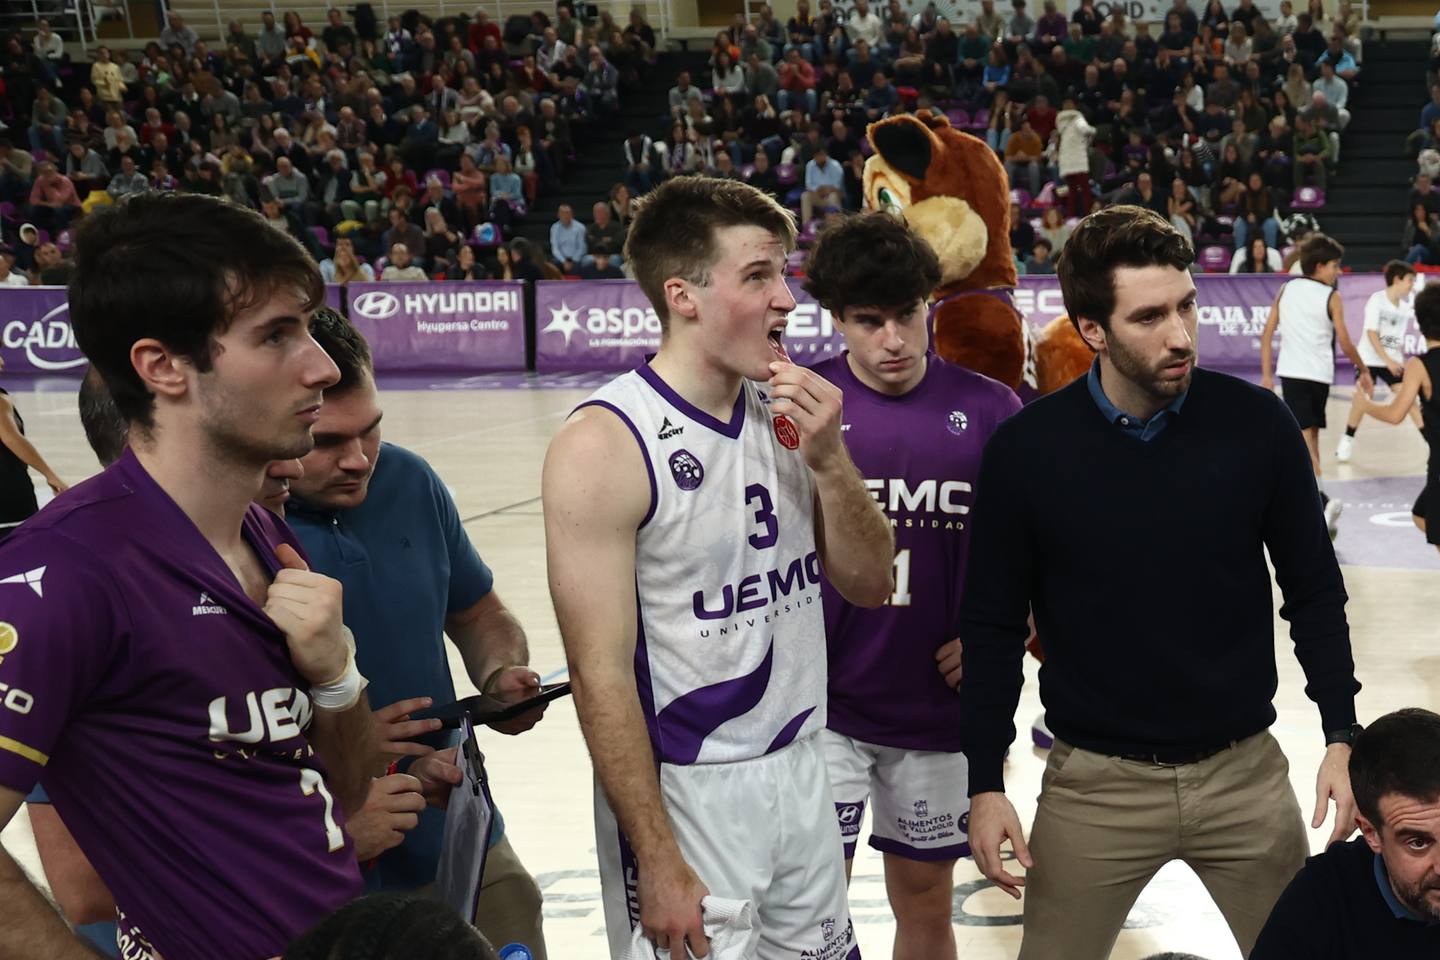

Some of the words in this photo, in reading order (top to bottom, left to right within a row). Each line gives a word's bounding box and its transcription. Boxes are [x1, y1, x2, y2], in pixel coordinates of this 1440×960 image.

[405, 291, 518, 314] HYUNDAI
[3, 320, 79, 349] CADI
[417, 319, 469, 333] Hyupersa
[470, 319, 509, 331] Centro
[587, 307, 662, 336] aspa
[864, 478, 972, 515] EMC
[744, 483, 778, 550] 3
[890, 518, 965, 531] RSIDAD
[693, 550, 822, 621] UEMC
[192, 605, 228, 616] MERCURY
